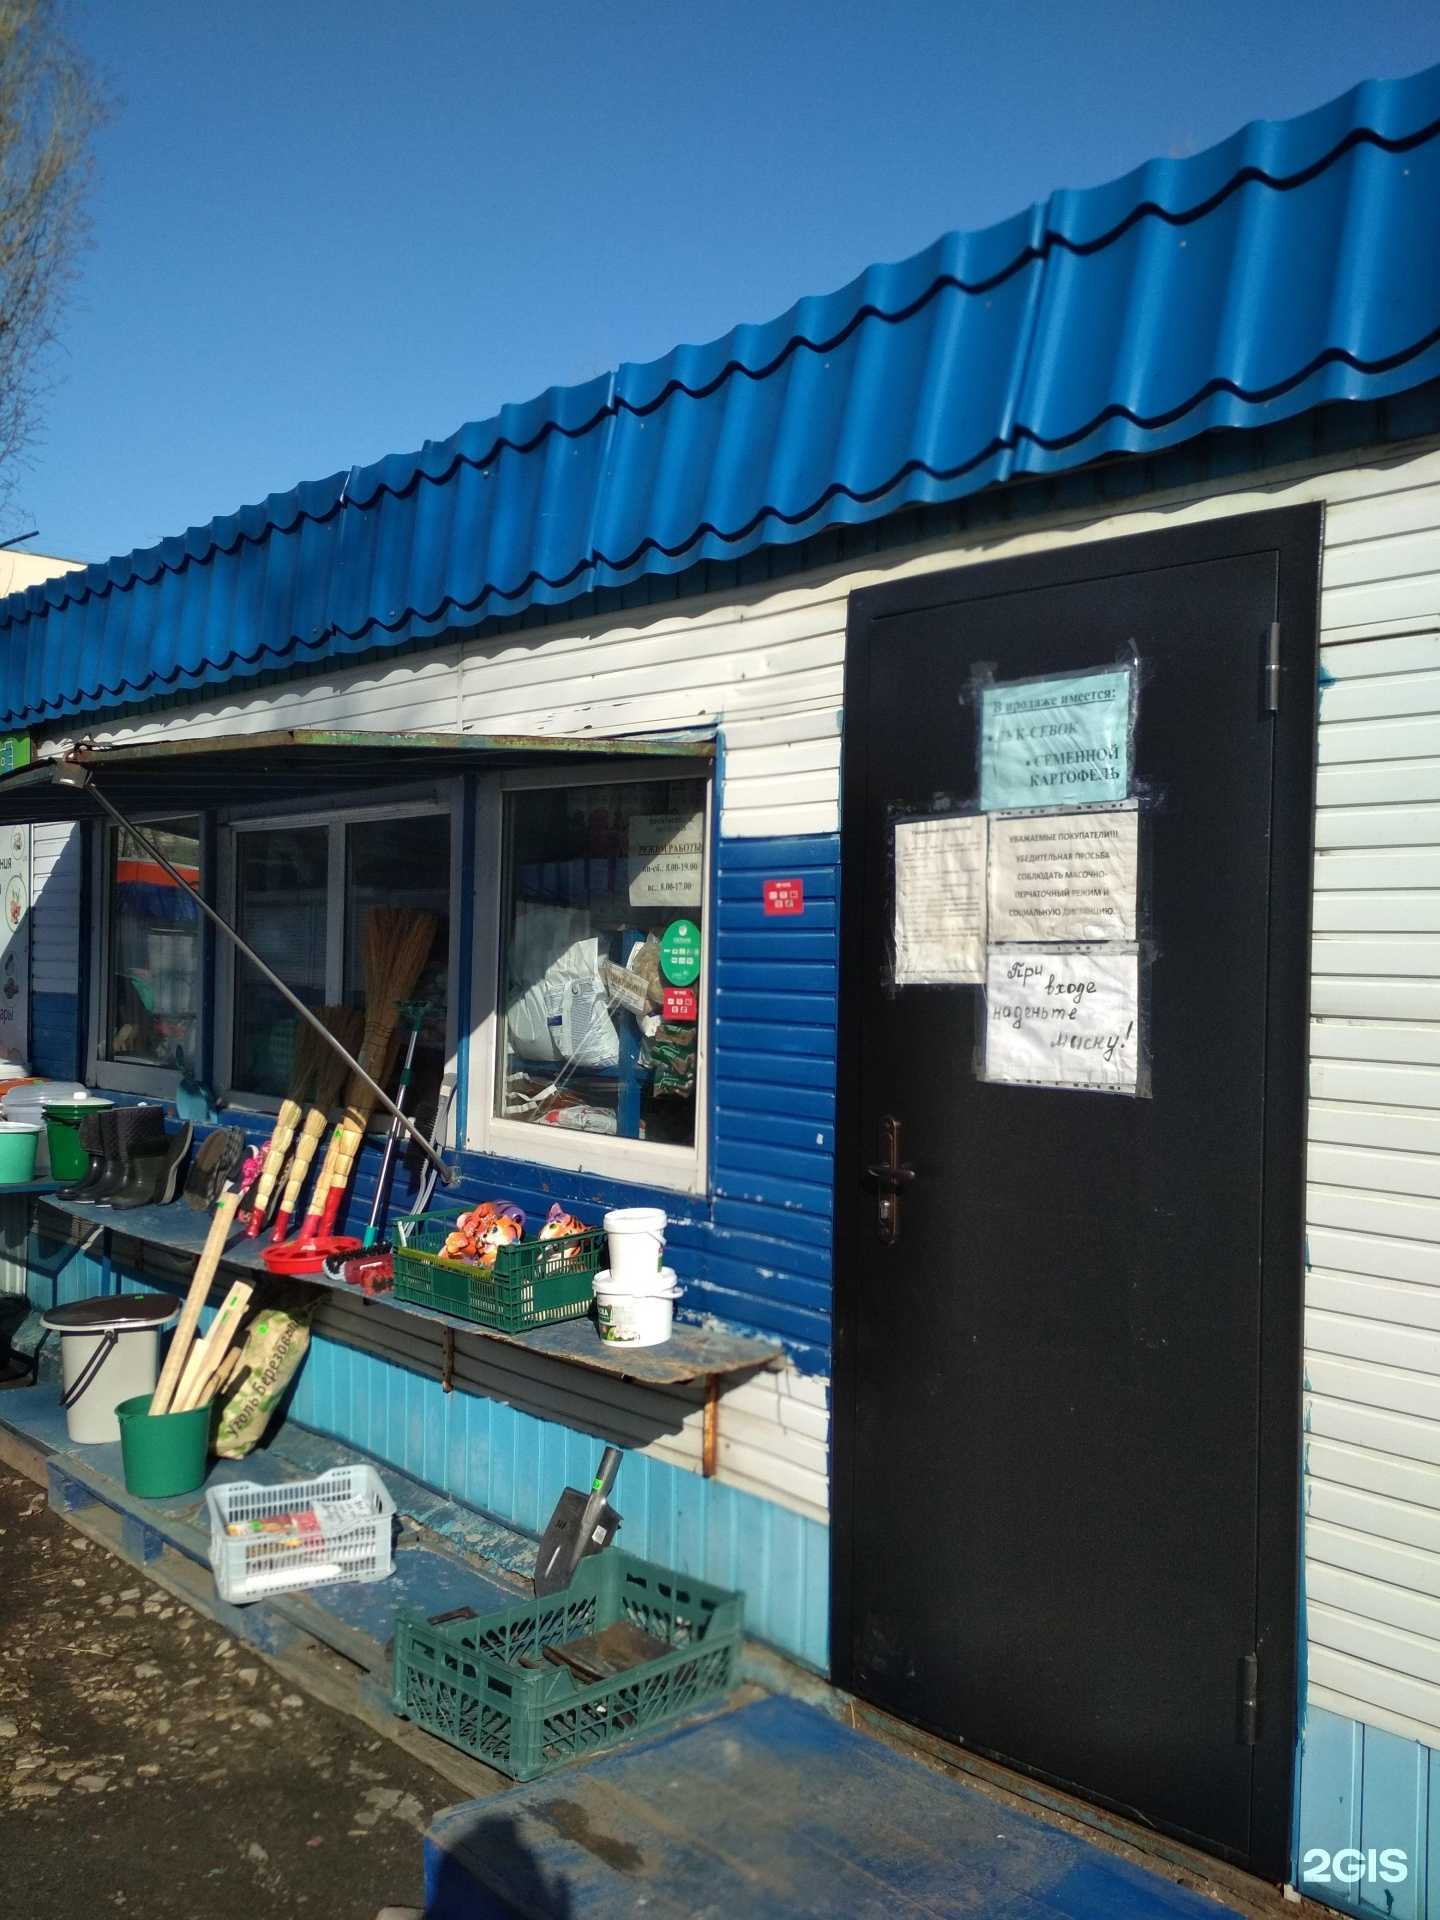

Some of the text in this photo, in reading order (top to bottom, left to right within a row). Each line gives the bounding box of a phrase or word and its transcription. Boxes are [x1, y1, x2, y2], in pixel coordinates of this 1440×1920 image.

[1033, 744, 1119, 767] СЕМЕННОЙ
[1029, 767, 1120, 788] КАРТОФЕЛЬ
[1007, 961, 1044, 987] При
[1044, 973, 1097, 1004] входе
[992, 1005, 1077, 1029] наденьте
[1050, 1020, 1134, 1062] маску!
[226, 1397, 260, 1438] Уголь
